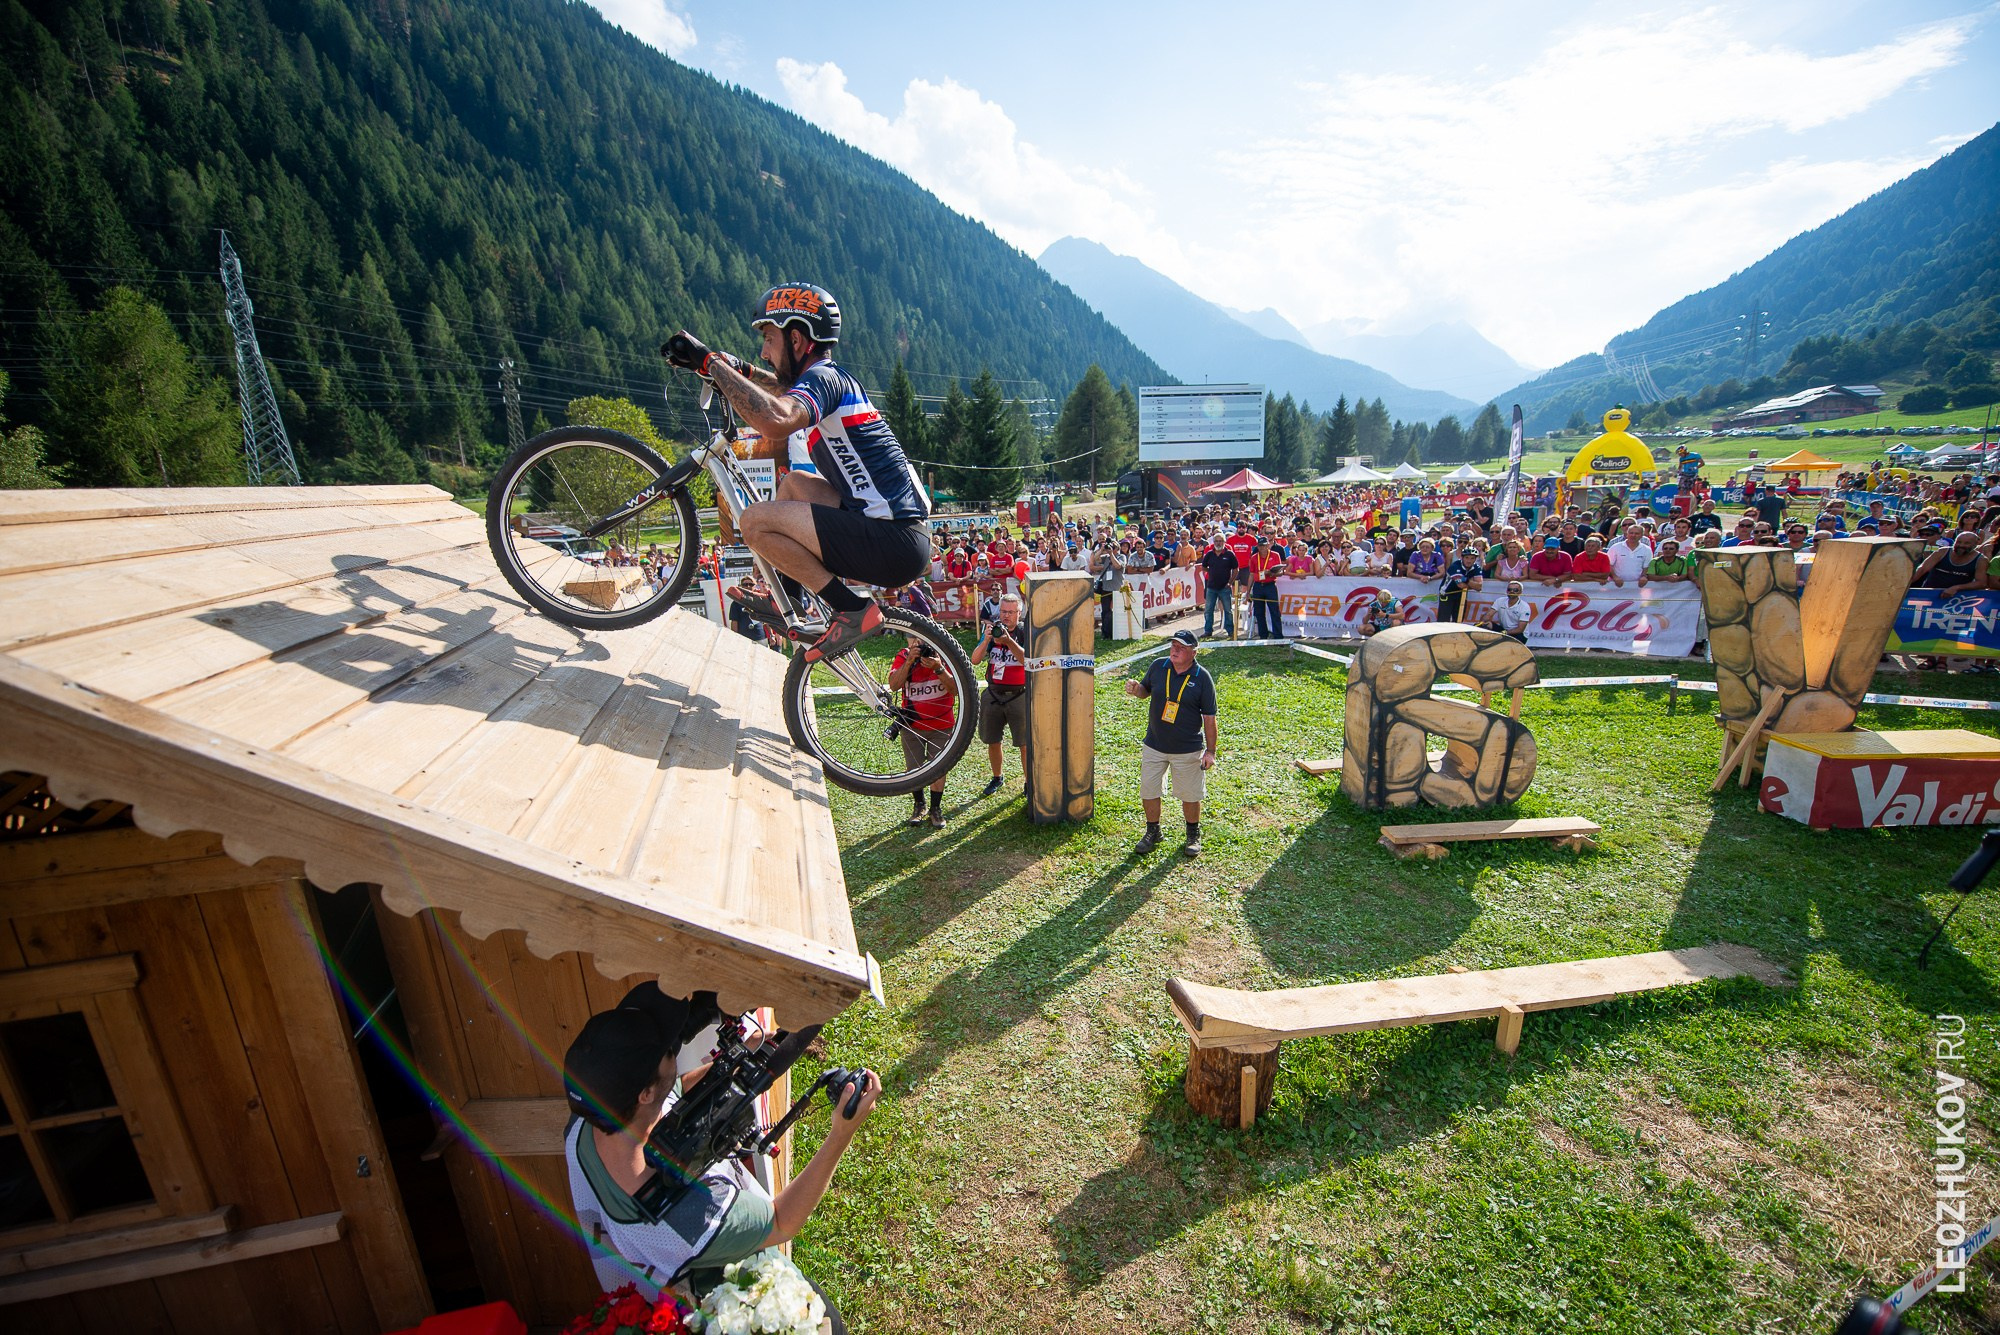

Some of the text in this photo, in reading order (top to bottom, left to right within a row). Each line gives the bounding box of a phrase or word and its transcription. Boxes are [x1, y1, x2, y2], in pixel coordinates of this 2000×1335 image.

[771, 288, 823, 304] TRIAL
[765, 298, 824, 314] BIKES
[827, 436, 870, 491] FRANCE
[1592, 458, 1631, 469] Melinda
[1155, 590, 1165, 607] di
[1281, 596, 1332, 616] IPER
[1281, 620, 1348, 630] PERCONVENIENZA
[1907, 599, 1999, 635] TREN
[1549, 632, 1577, 640] TUTTI
[1851, 764, 1988, 828] Val di
